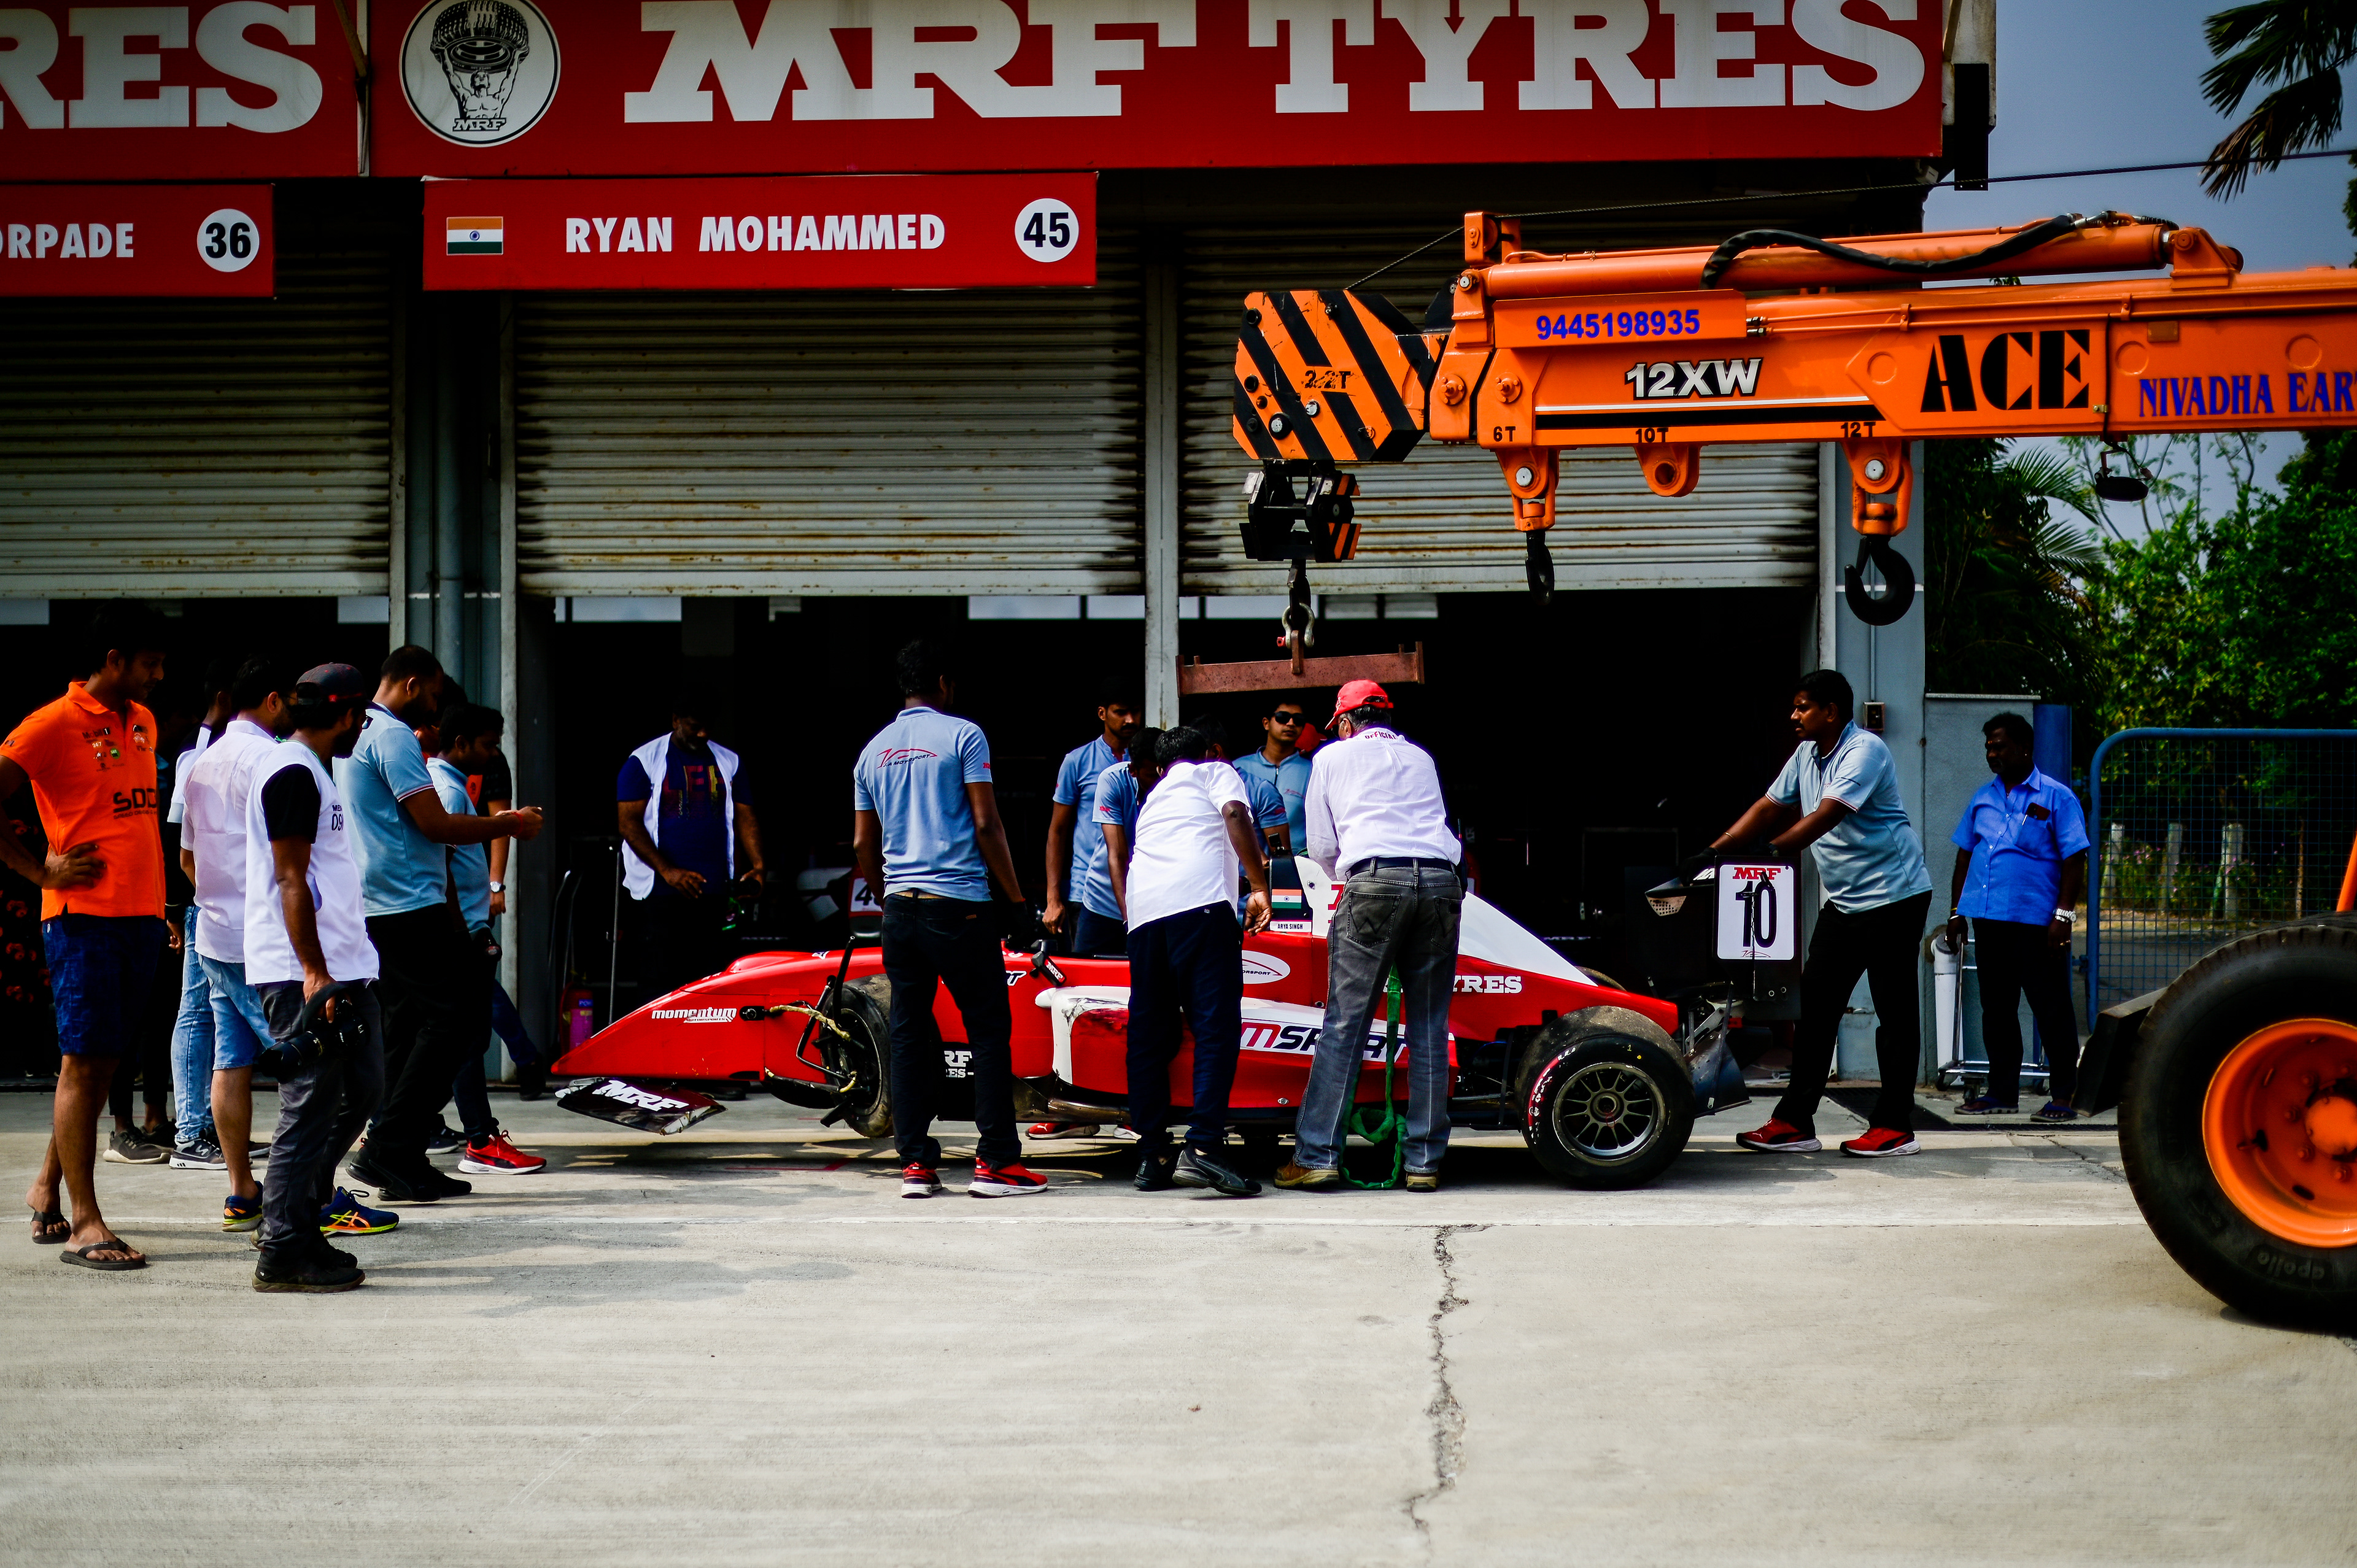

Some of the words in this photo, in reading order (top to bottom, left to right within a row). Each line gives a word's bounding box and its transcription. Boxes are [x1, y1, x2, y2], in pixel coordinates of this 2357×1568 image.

[624, 0, 1196, 122] MRF
[1248, 0, 1925, 112] TYRES
[453, 118, 506, 131] MRF
[0, 223, 134, 258] RPADE
[204, 222, 251, 258] 36
[566, 217, 672, 253] RYAN
[699, 214, 945, 252] MOHAMMED
[1023, 212, 1070, 248] 45
[1536, 309, 1700, 341] 9445198935
[1625, 358, 1762, 400] 12XW
[1920, 329, 2091, 413] ACE
[2139, 374, 2275, 417] NIVADHA
[2288, 371, 2357, 412] EAR
[1493, 426, 1516, 442] 6T
[1635, 428, 1669, 443] 10T
[1841, 422, 1876, 438] 12T
[1733, 867, 1781, 880] MRF
[1735, 881, 1777, 948] 10
[1046, 960, 1064, 980] MRF
[651, 1006, 737, 1019] momentum
[592, 1079, 690, 1112] MRF
